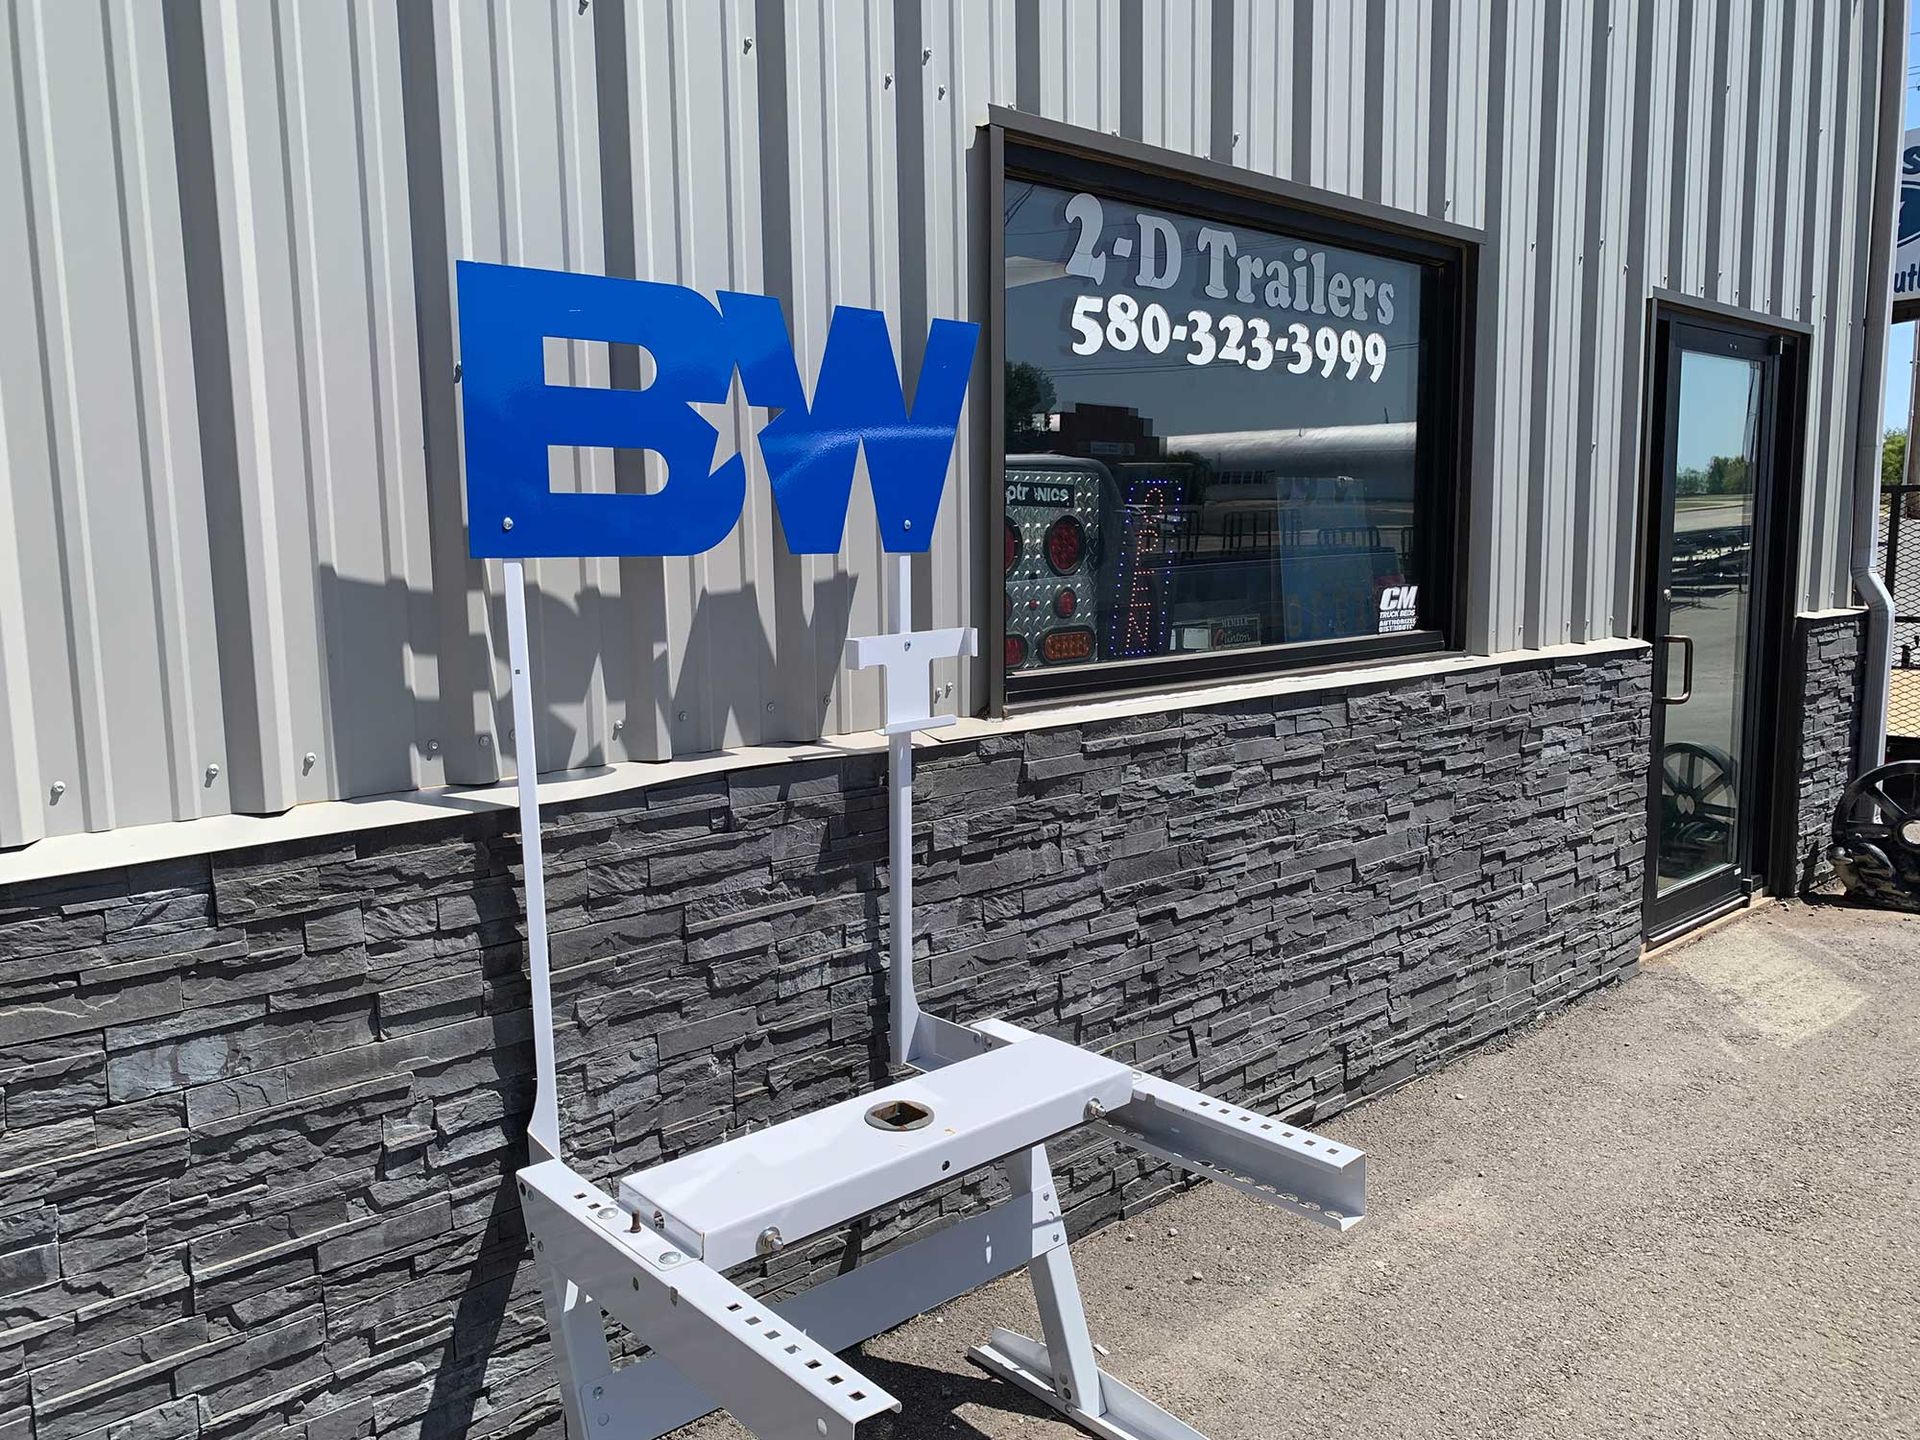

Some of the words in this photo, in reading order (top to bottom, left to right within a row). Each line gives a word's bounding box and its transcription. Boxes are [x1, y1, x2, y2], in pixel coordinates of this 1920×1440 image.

[1065, 192, 1183, 290] 2-D
[1197, 226, 1395, 326] Trailers
[1070, 294, 1387, 384] 580-323-3999
[456, 260, 982, 559] BW
[1126, 487, 1165, 648] OPEN
[1379, 610, 1400, 619] TRUCK
